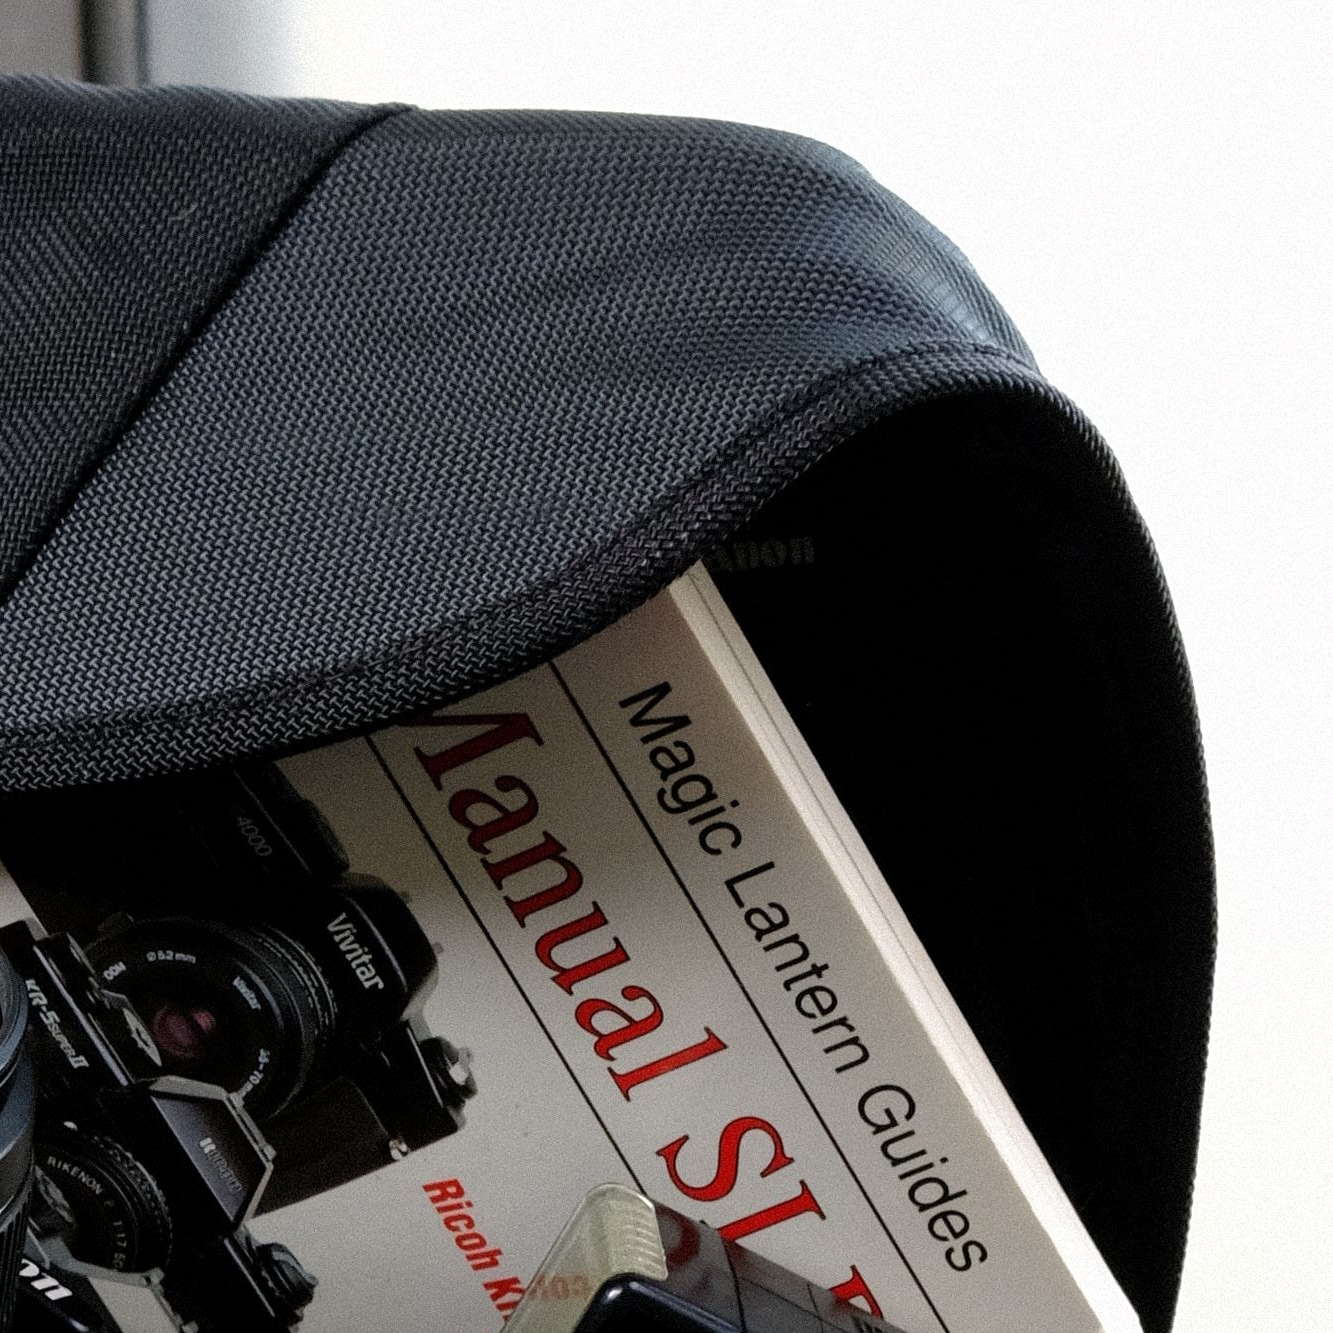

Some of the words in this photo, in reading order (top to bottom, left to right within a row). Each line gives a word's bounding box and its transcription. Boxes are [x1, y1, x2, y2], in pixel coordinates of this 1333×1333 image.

[326, 912, 386, 991] Vivitar
[619, 681, 743, 856] Magic
[724, 861, 870, 1074] Lantern
[857, 1084, 989, 1273] Guides
[47, 1156, 104, 1195] RIKENON
[422, 1178, 503, 1271] Ricoh
